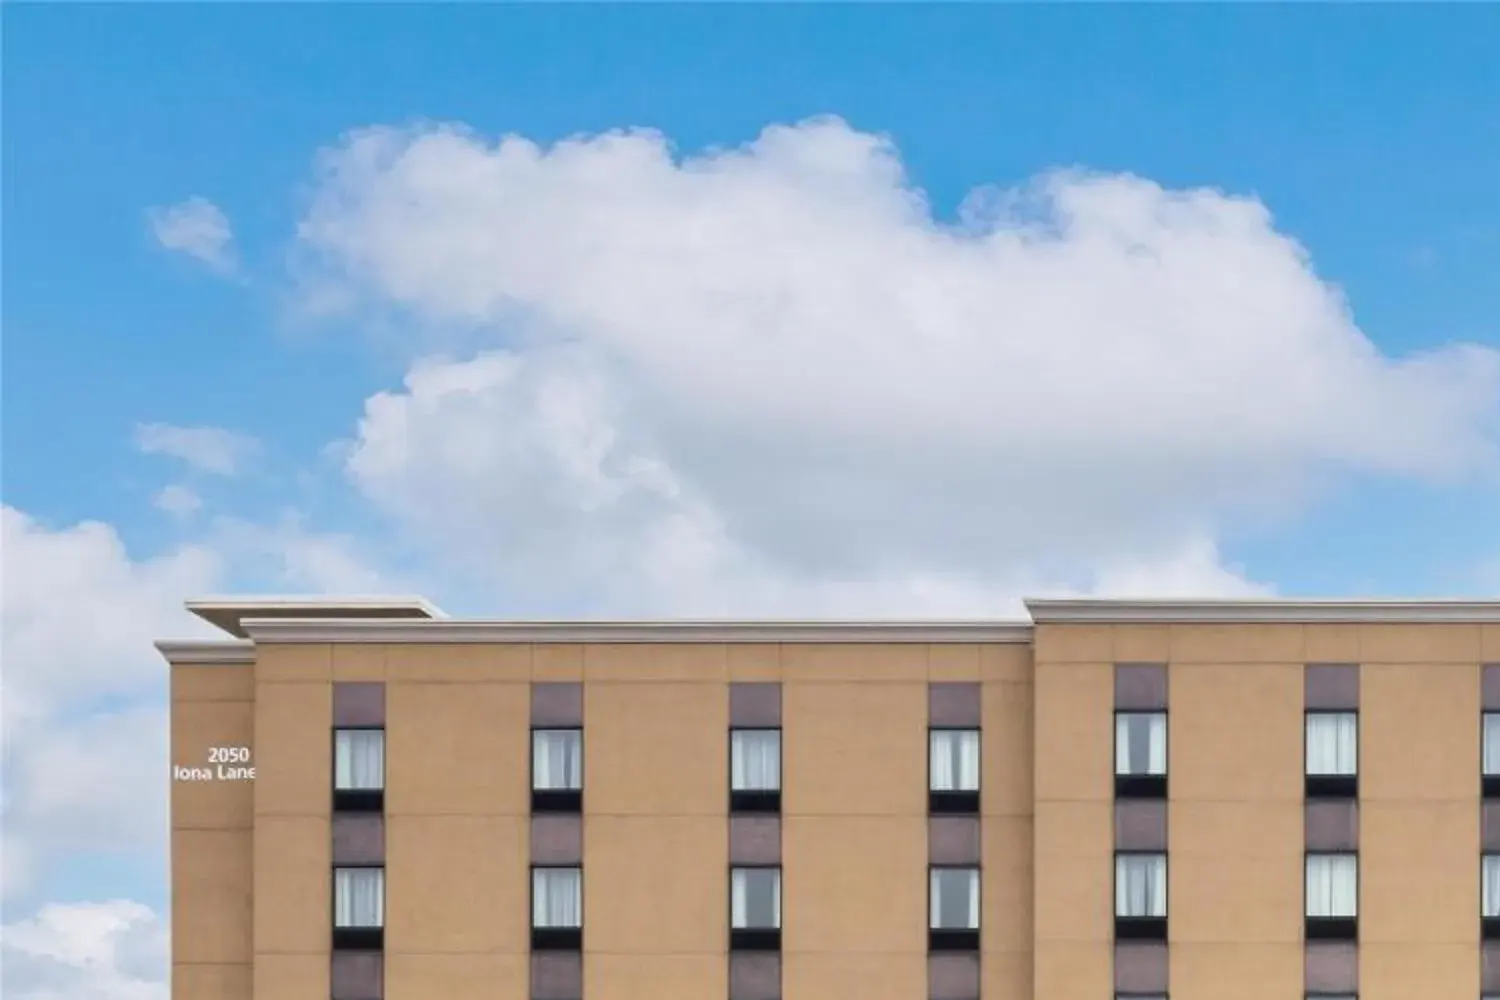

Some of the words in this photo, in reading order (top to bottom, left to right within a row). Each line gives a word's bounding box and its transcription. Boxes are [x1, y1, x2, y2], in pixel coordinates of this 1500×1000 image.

[207, 747, 250, 763] 2050
[173, 765, 213, 781] Iona
[217, 764, 256, 780] Lane
